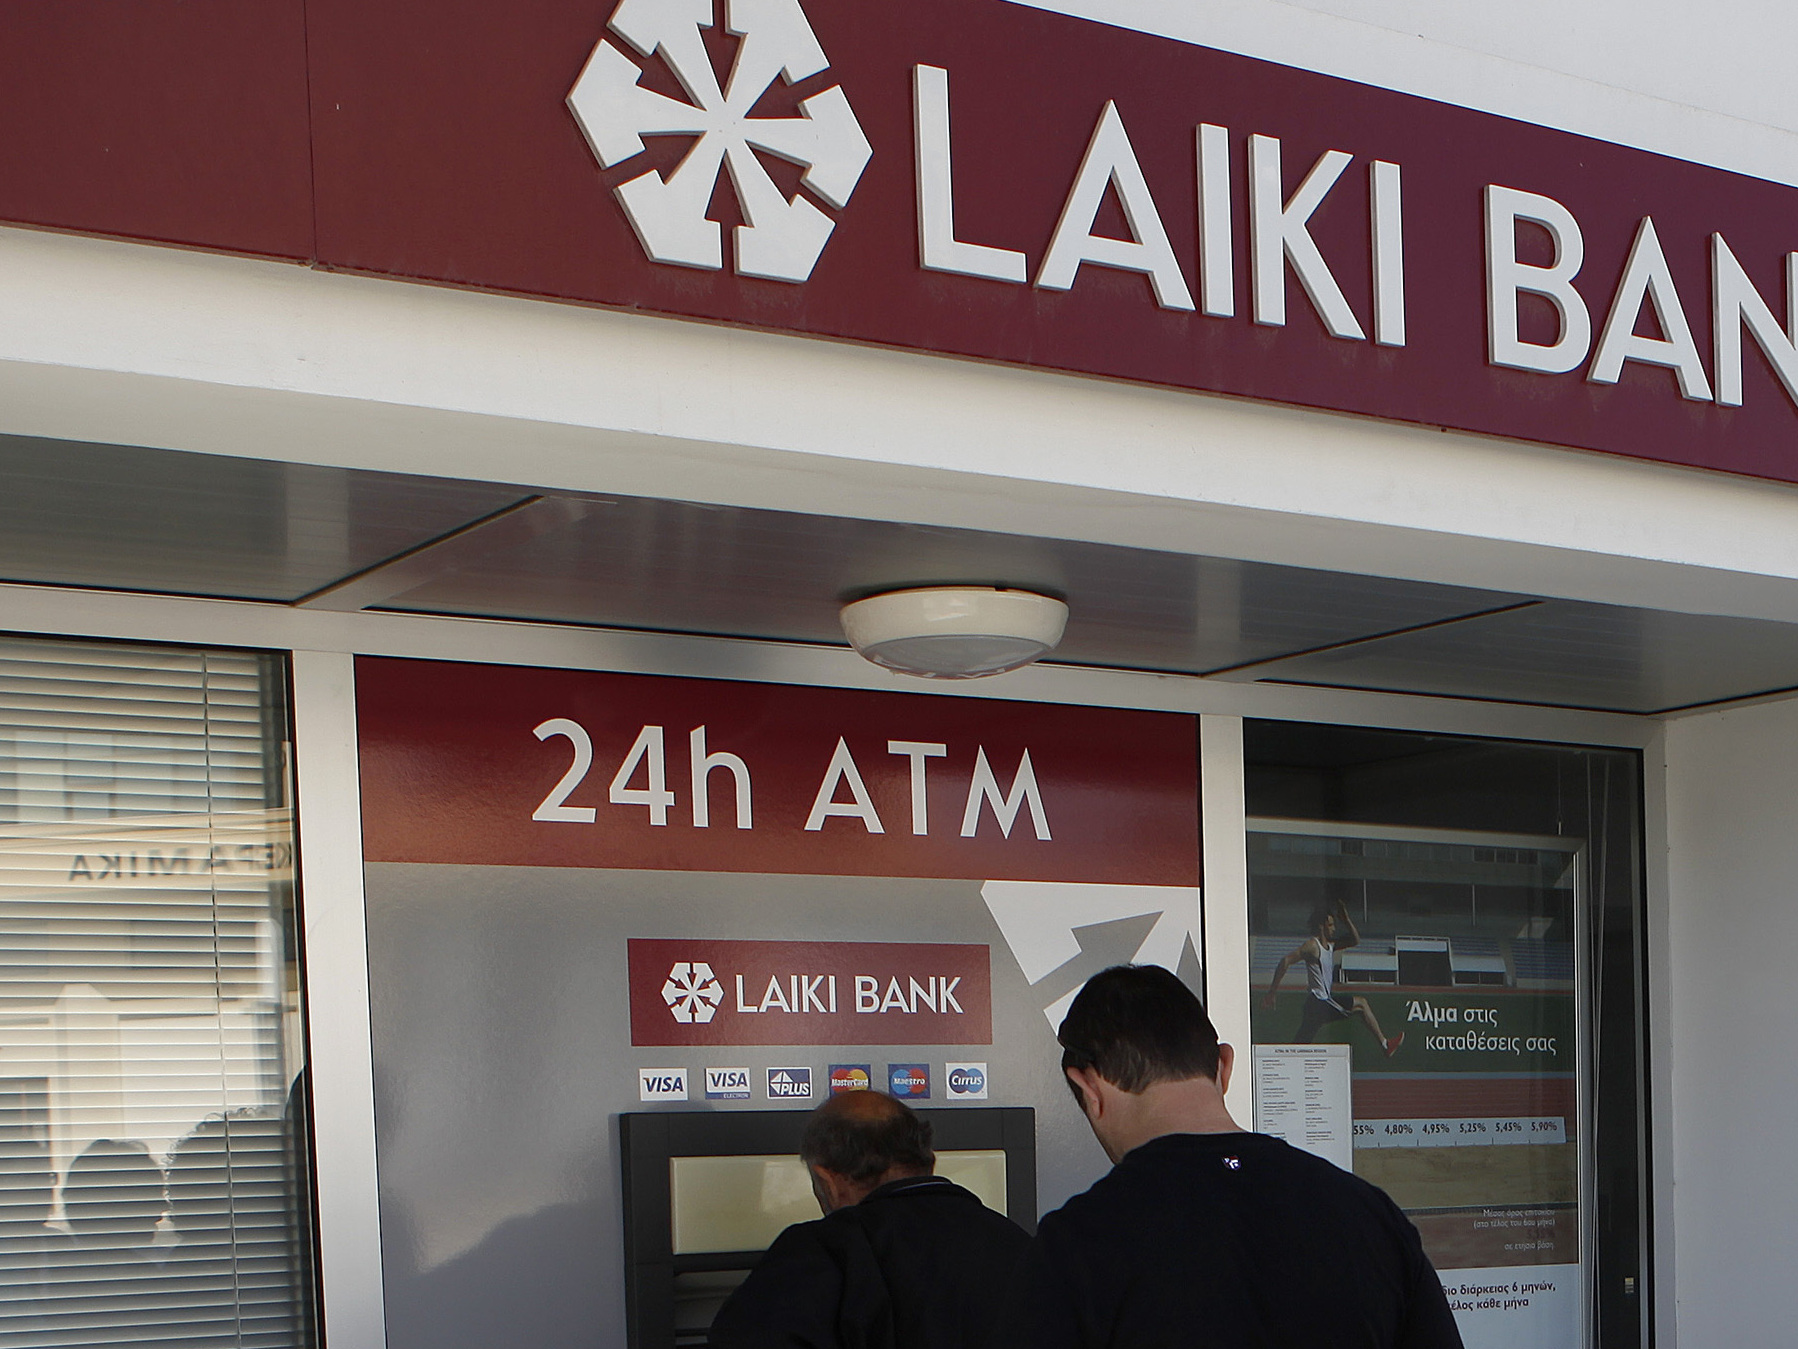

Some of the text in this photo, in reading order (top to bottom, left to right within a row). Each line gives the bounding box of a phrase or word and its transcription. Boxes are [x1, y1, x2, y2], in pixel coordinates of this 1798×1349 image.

[912, 63, 1406, 347] LAIKI
[531, 717, 1053, 841] 24h ATM
[736, 974, 964, 1014] LAIKI BANK
[1405, 1000, 1498, 1028] Άλμα στις
[1425, 1030, 1557, 1056] καταθέσεις σας
[643, 1077, 684, 1093] VISA
[709, 1072, 748, 1088] VISA
[831, 1078, 869, 1088] MasterCard
[894, 1077, 926, 1086] Maestro
[951, 1075, 983, 1086] Cirrus
[780, 1083, 810, 1096] PLUS
[1353, 1121, 1558, 1136] 55% 4,80% 4,95% 5,25% 5,45% 5,90%
[1442, 1285, 1457, 1296] διο
[1460, 1284, 1509, 1296] διάρκειας
[1512, 1281, 1518, 1292] 6
[1477, 1297, 1500, 1309] κάθε
[1504, 1297, 1529, 1310] μήνα
